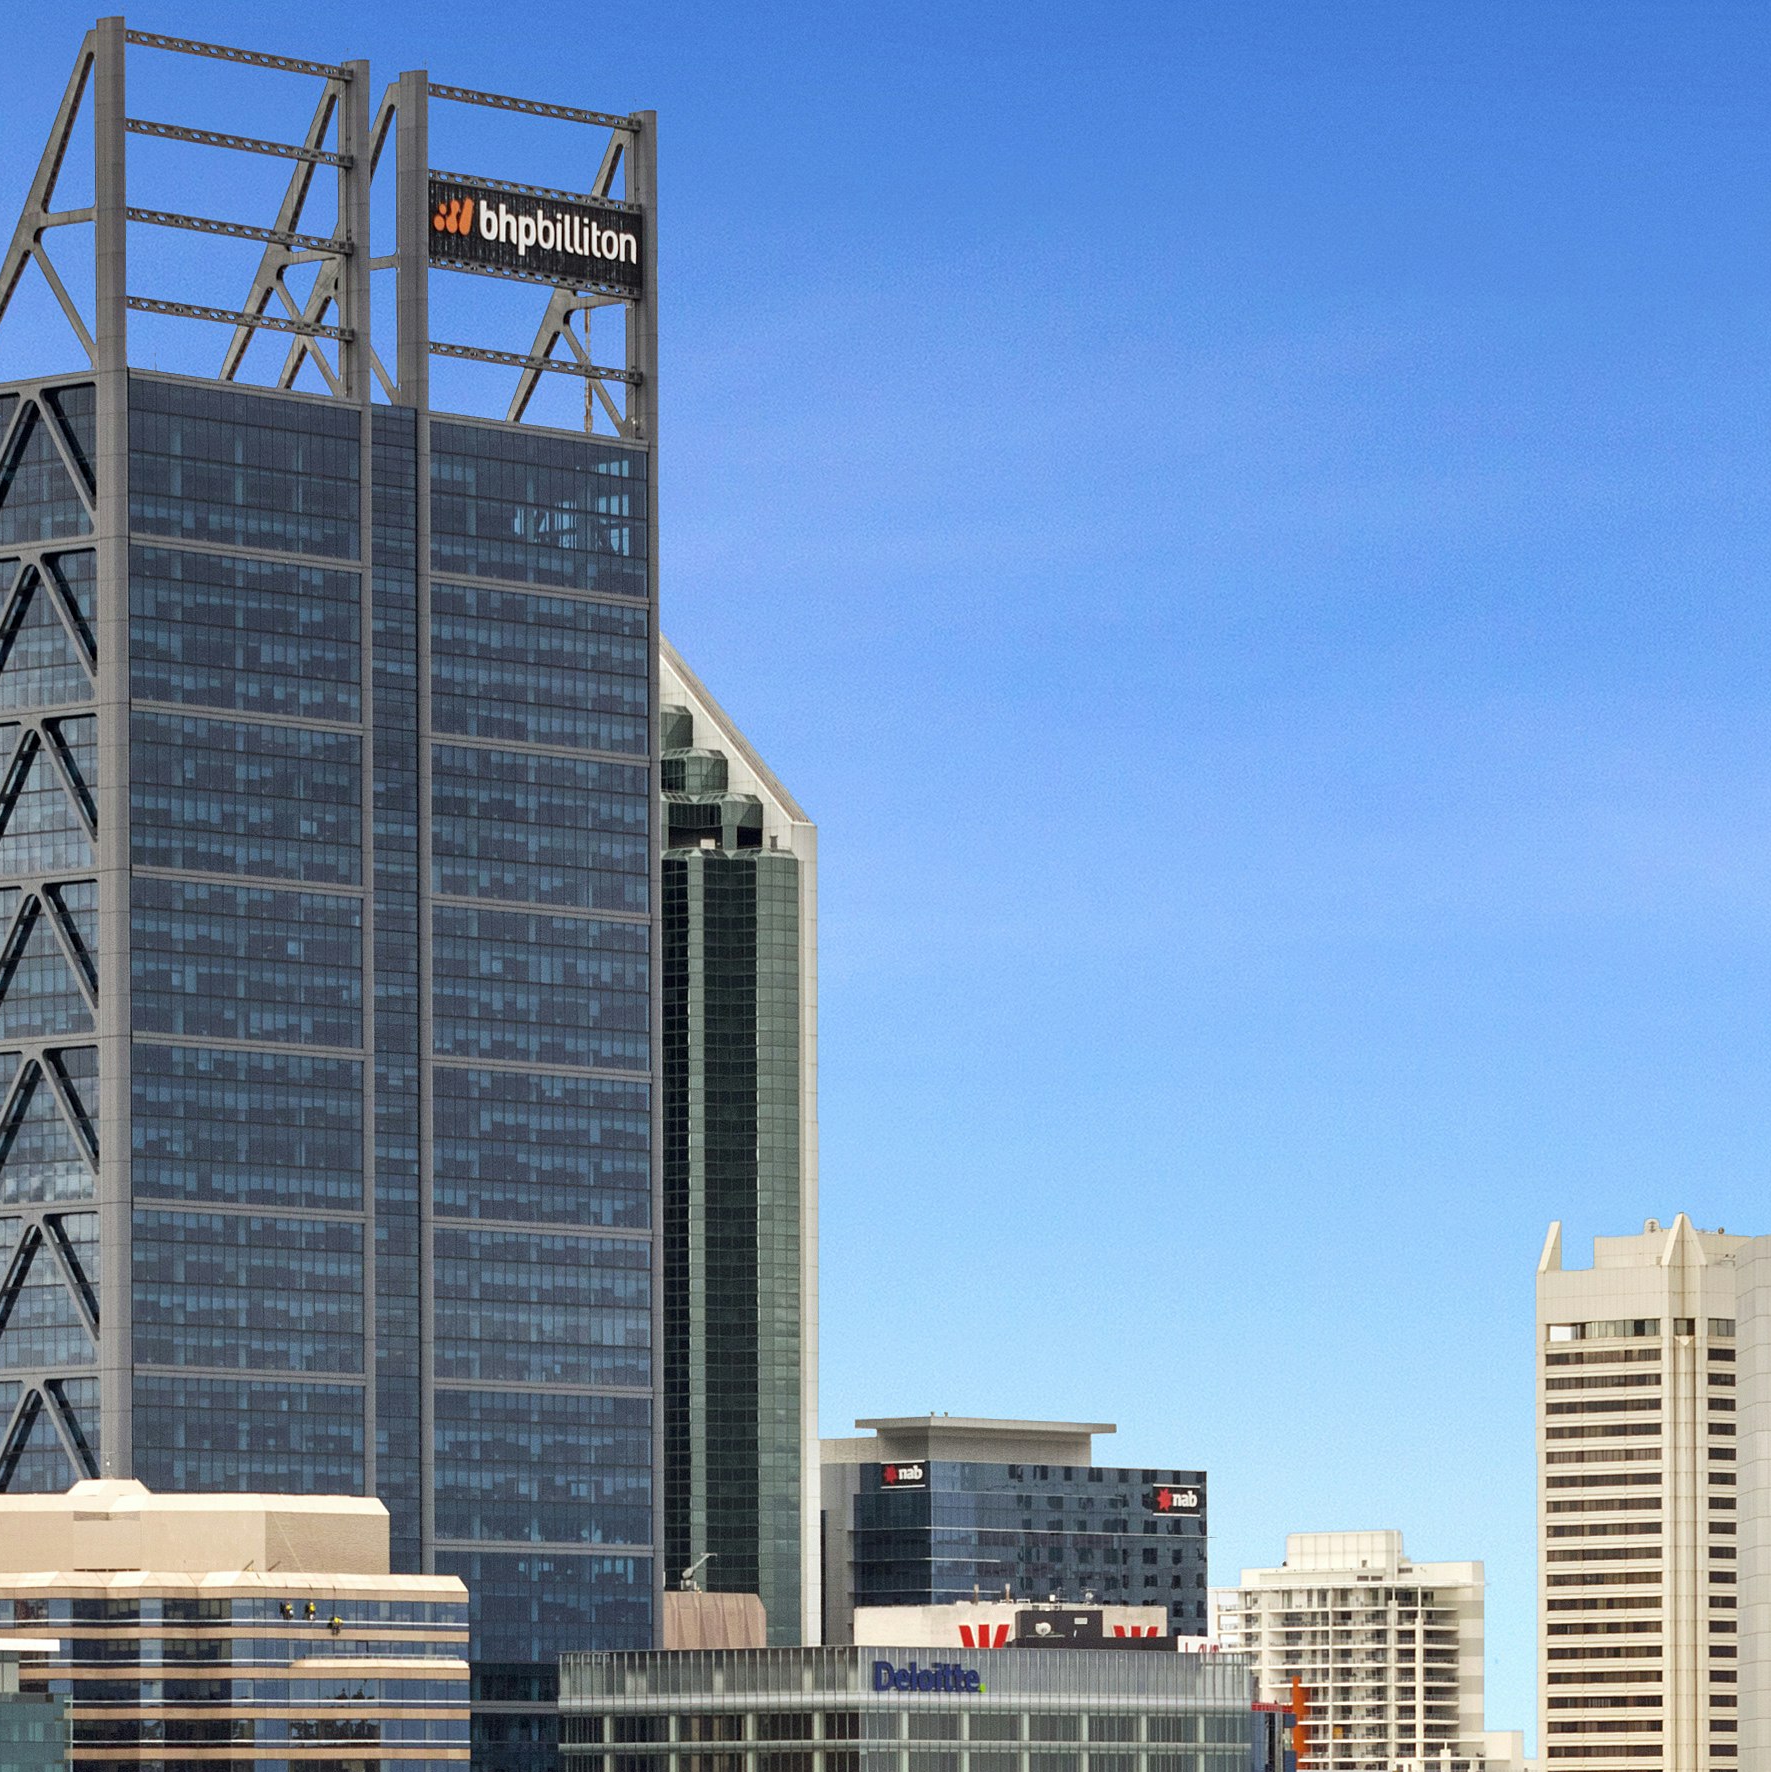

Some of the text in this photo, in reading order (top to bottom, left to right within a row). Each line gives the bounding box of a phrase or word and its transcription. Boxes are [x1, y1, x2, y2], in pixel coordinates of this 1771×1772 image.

[480, 199, 638, 265] bhpbilliton
[898, 1465, 923, 1481] nab
[1172, 1491, 1198, 1508] nab
